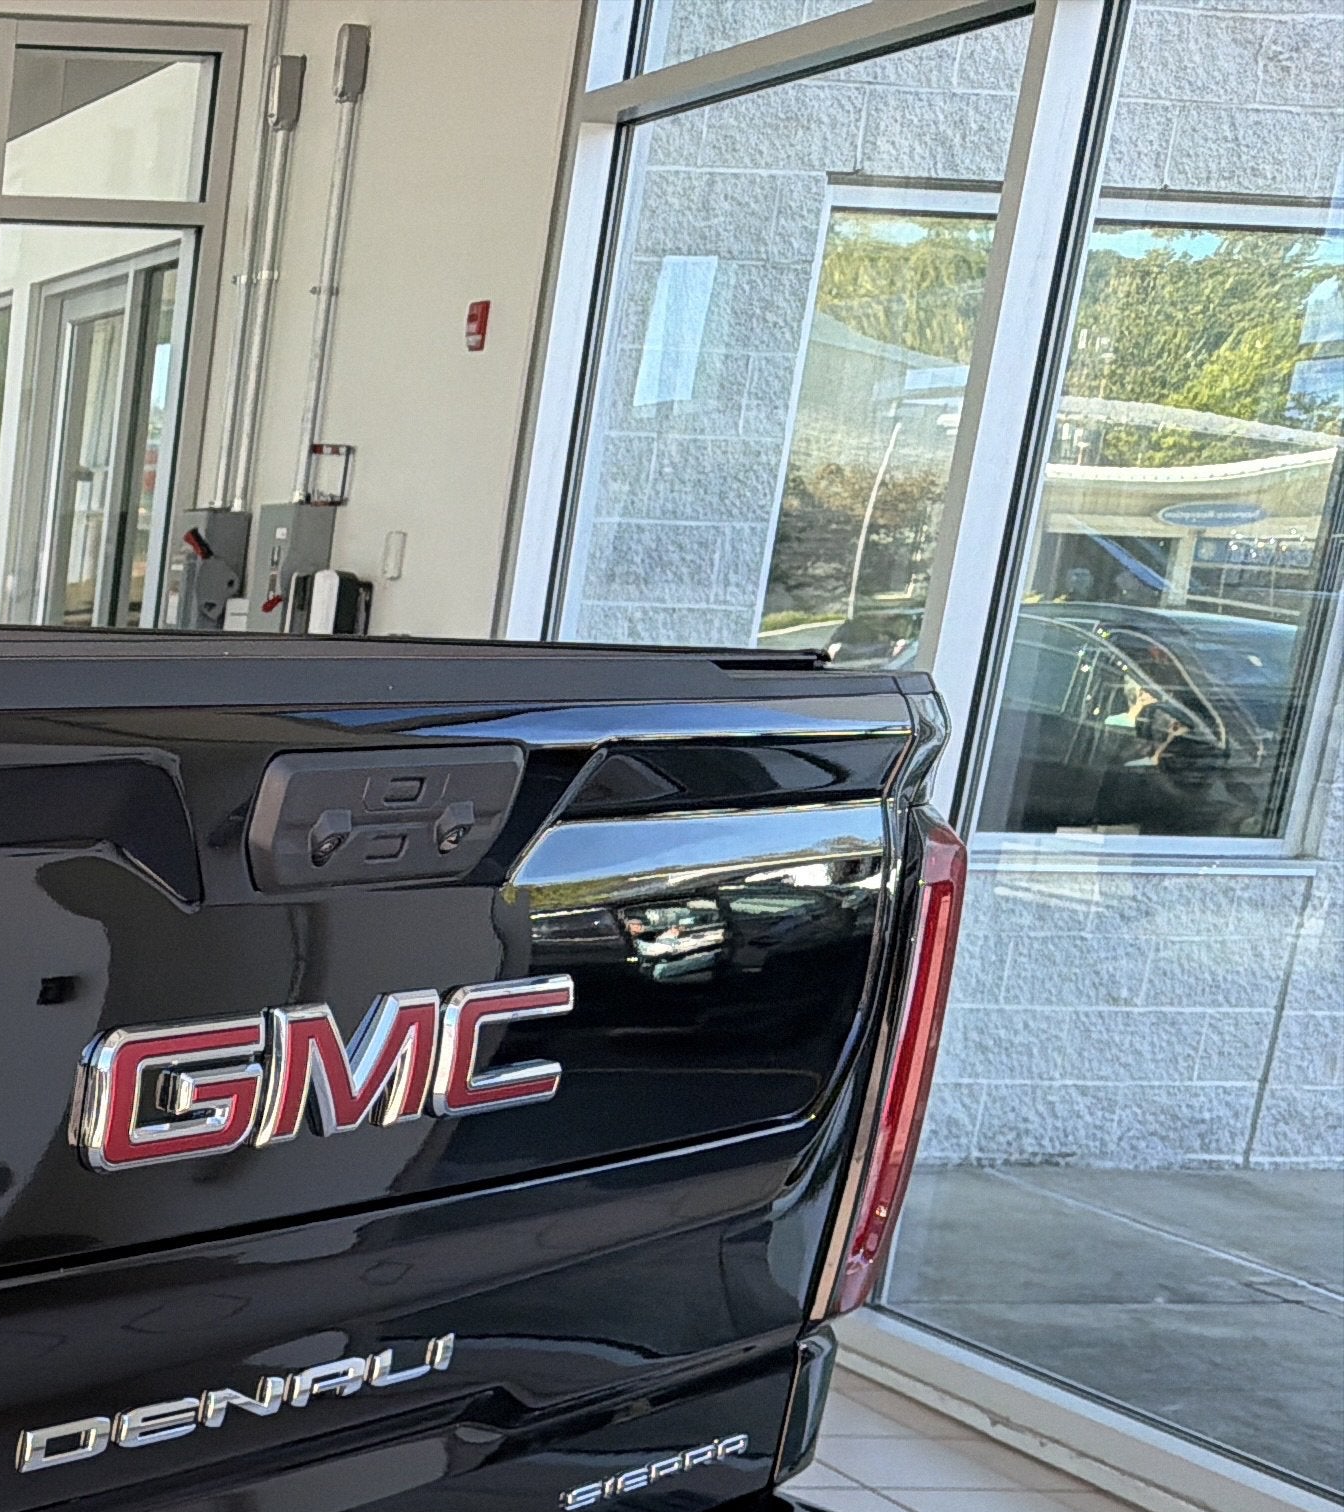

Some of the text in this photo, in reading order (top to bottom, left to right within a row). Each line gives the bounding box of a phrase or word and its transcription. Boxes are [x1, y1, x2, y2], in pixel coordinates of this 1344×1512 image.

[68, 973, 575, 1174] GMC
[15, 1332, 455, 1473] DENALI
[559, 1433, 749, 1512] SIERRA
